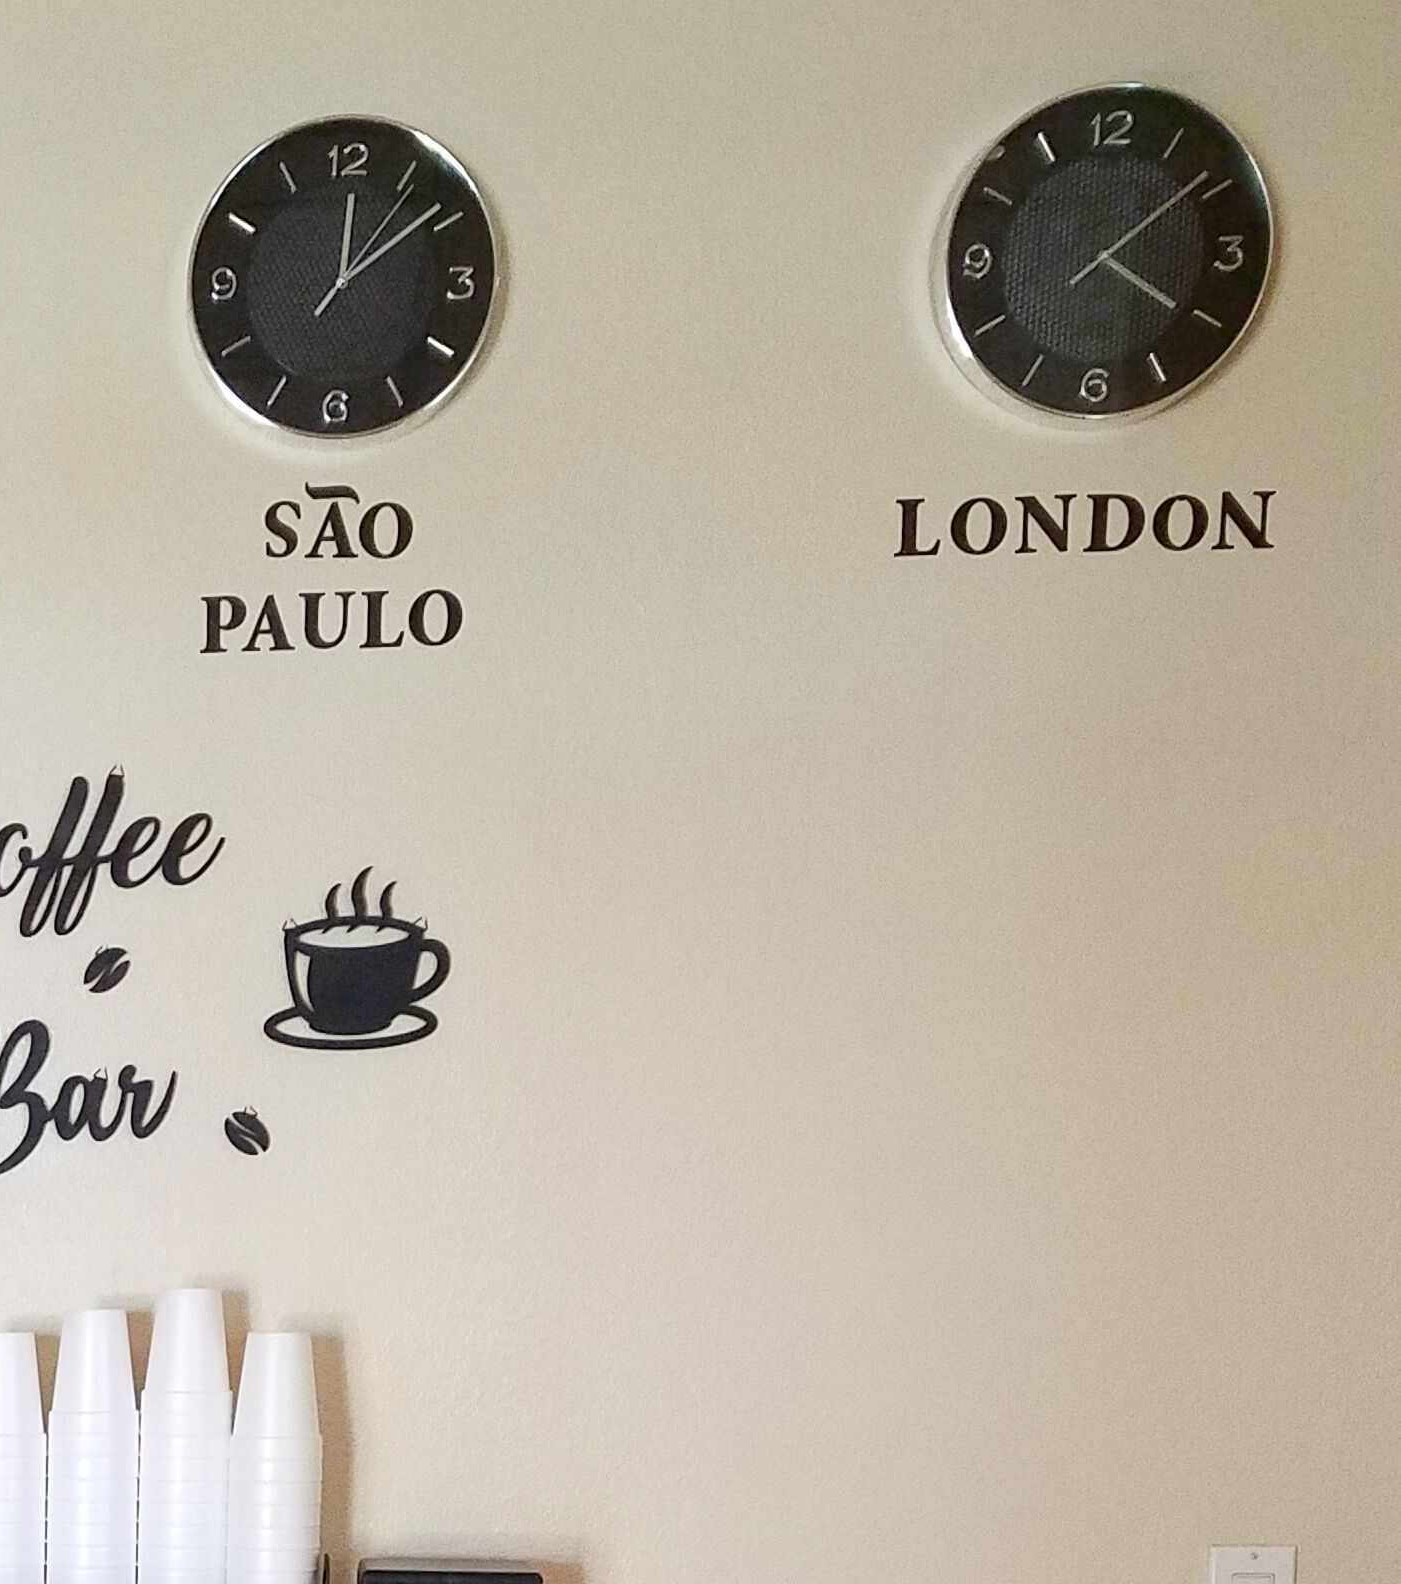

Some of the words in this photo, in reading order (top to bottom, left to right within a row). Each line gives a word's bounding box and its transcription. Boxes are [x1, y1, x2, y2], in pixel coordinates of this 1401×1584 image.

[1091, 110, 1134, 147] 12
[328, 143, 369, 178] 12
[963, 244, 993, 279] 9
[1213, 235, 1244, 271] 3
[211, 267, 237, 303] 9
[447, 266, 475, 299] 3
[1079, 368, 1110, 402] 6
[322, 390, 349, 424] 6
[264, 482, 414, 560] SÃO
[894, 490, 1277, 557] LONDON
[200, 589, 463, 654] PAULO
